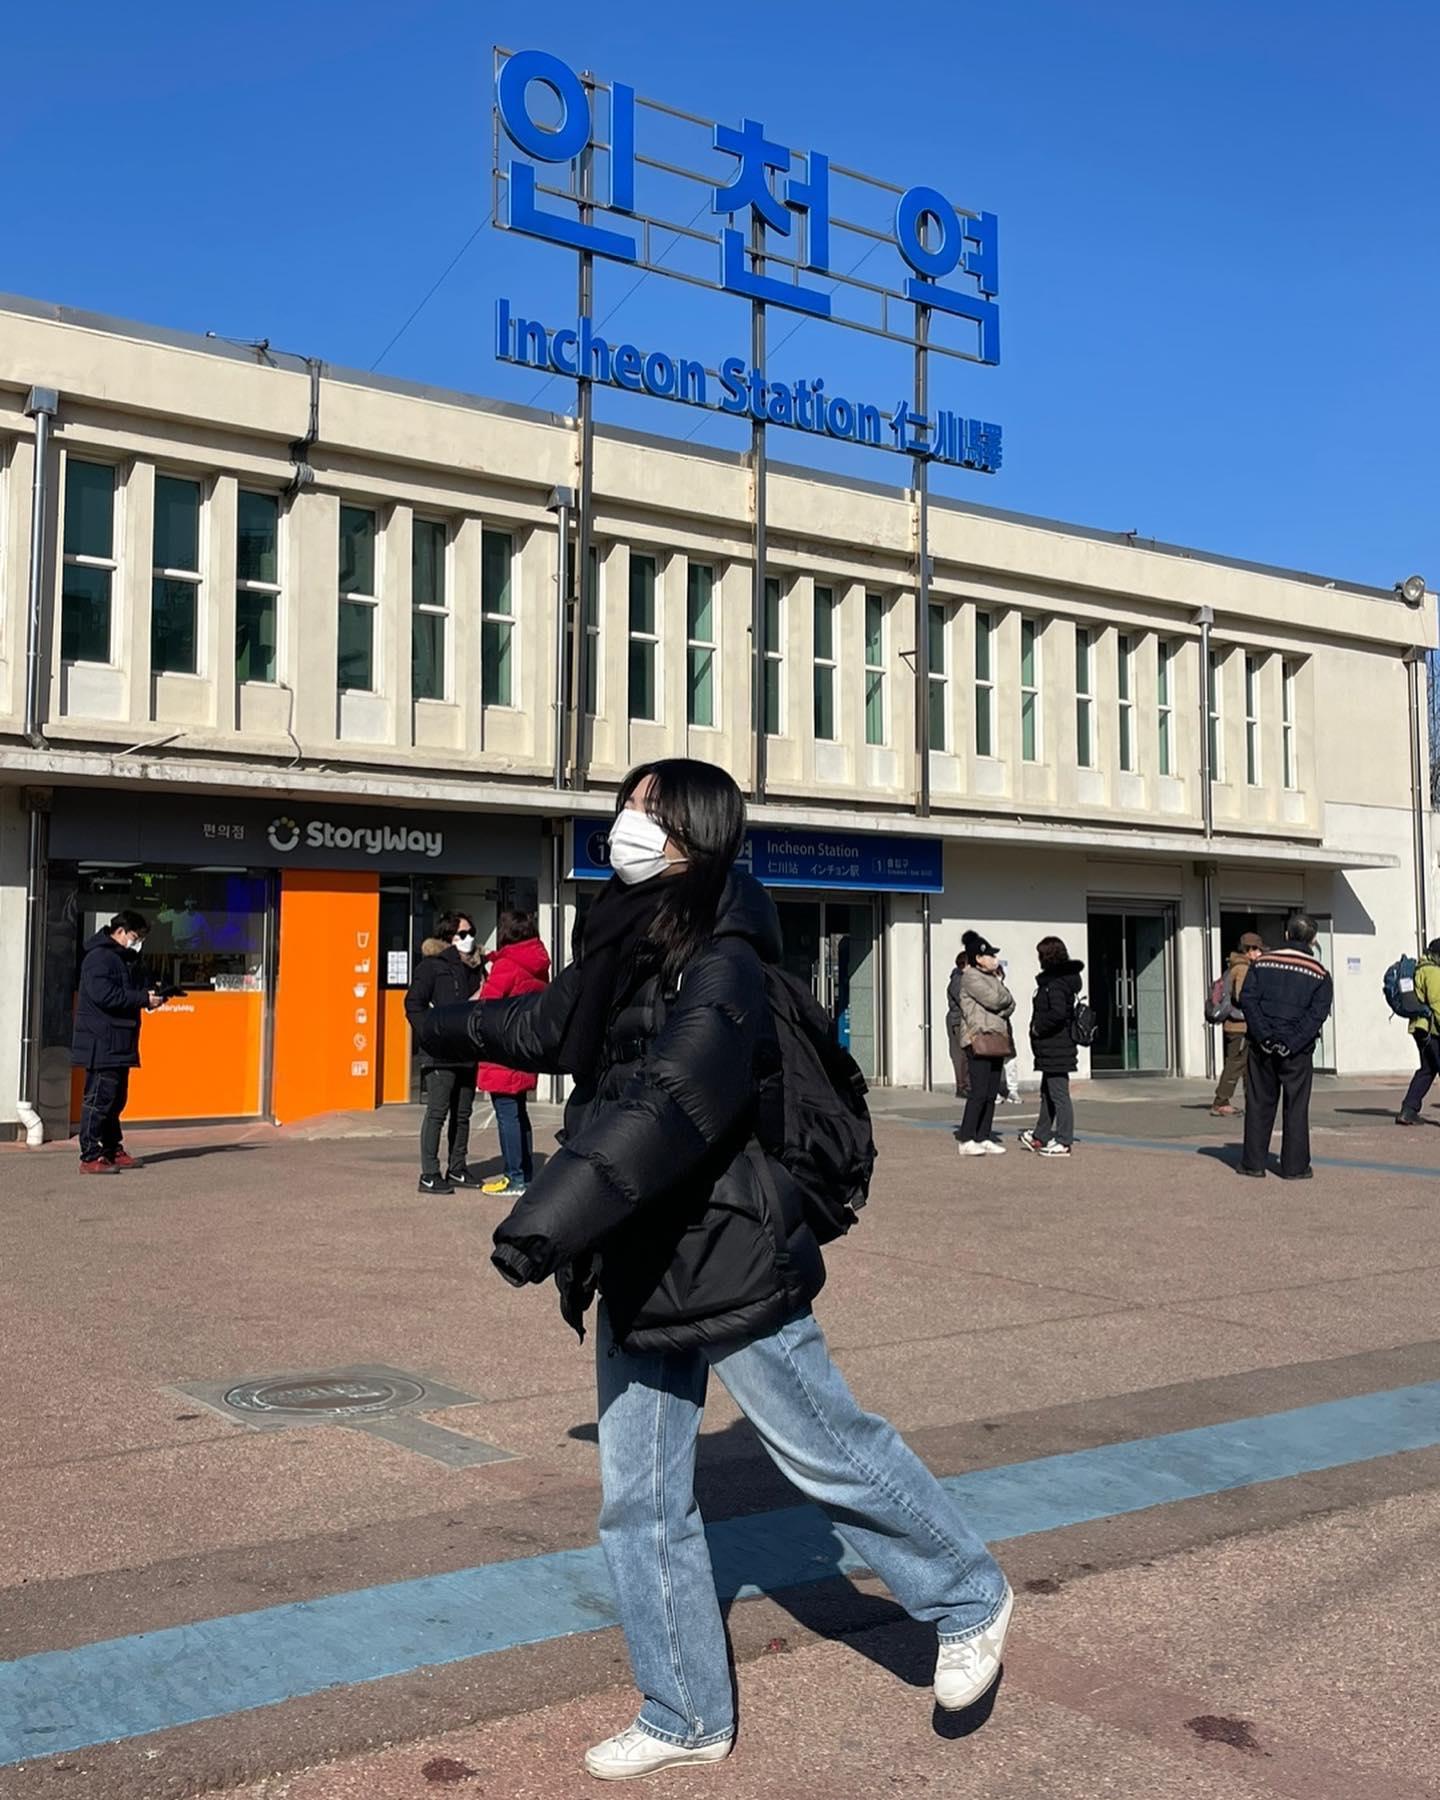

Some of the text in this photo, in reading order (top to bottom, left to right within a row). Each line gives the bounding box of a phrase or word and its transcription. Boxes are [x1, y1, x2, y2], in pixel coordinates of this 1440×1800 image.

[497, 49, 1000, 367] 인천역
[496, 297, 707, 405] Incheon
[719, 356, 882, 446] Station
[203, 823, 245, 840] 편의점
[306, 820, 443, 857] StoryWay
[767, 839, 859, 858] Incheon Station
[809, 862, 860, 878] インチョン駅
